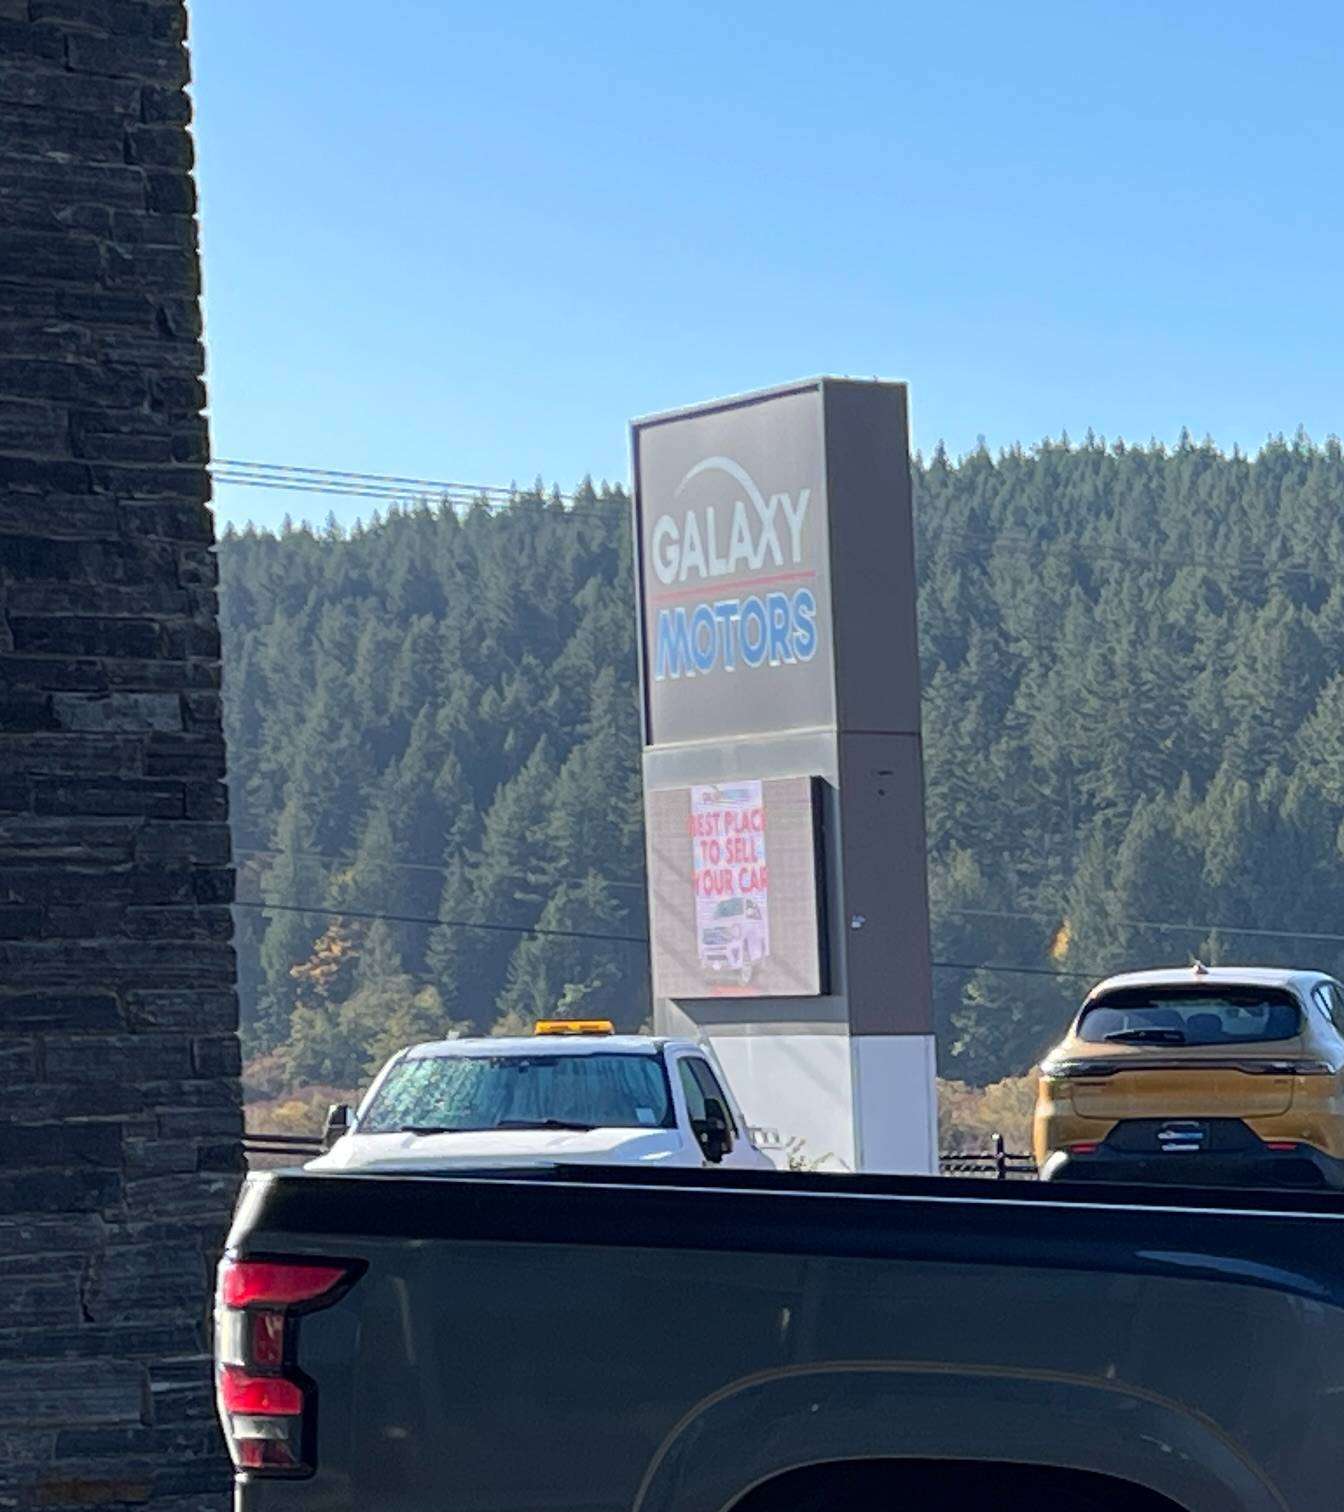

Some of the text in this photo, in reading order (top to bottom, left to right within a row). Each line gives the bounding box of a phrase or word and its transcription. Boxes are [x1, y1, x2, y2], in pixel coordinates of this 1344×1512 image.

[652, 488, 811, 585] GALAXY
[655, 587, 818, 682] MOTORS
[692, 866, 768, 897] YOUR CAR
[700, 836, 758, 865] TO SELL
